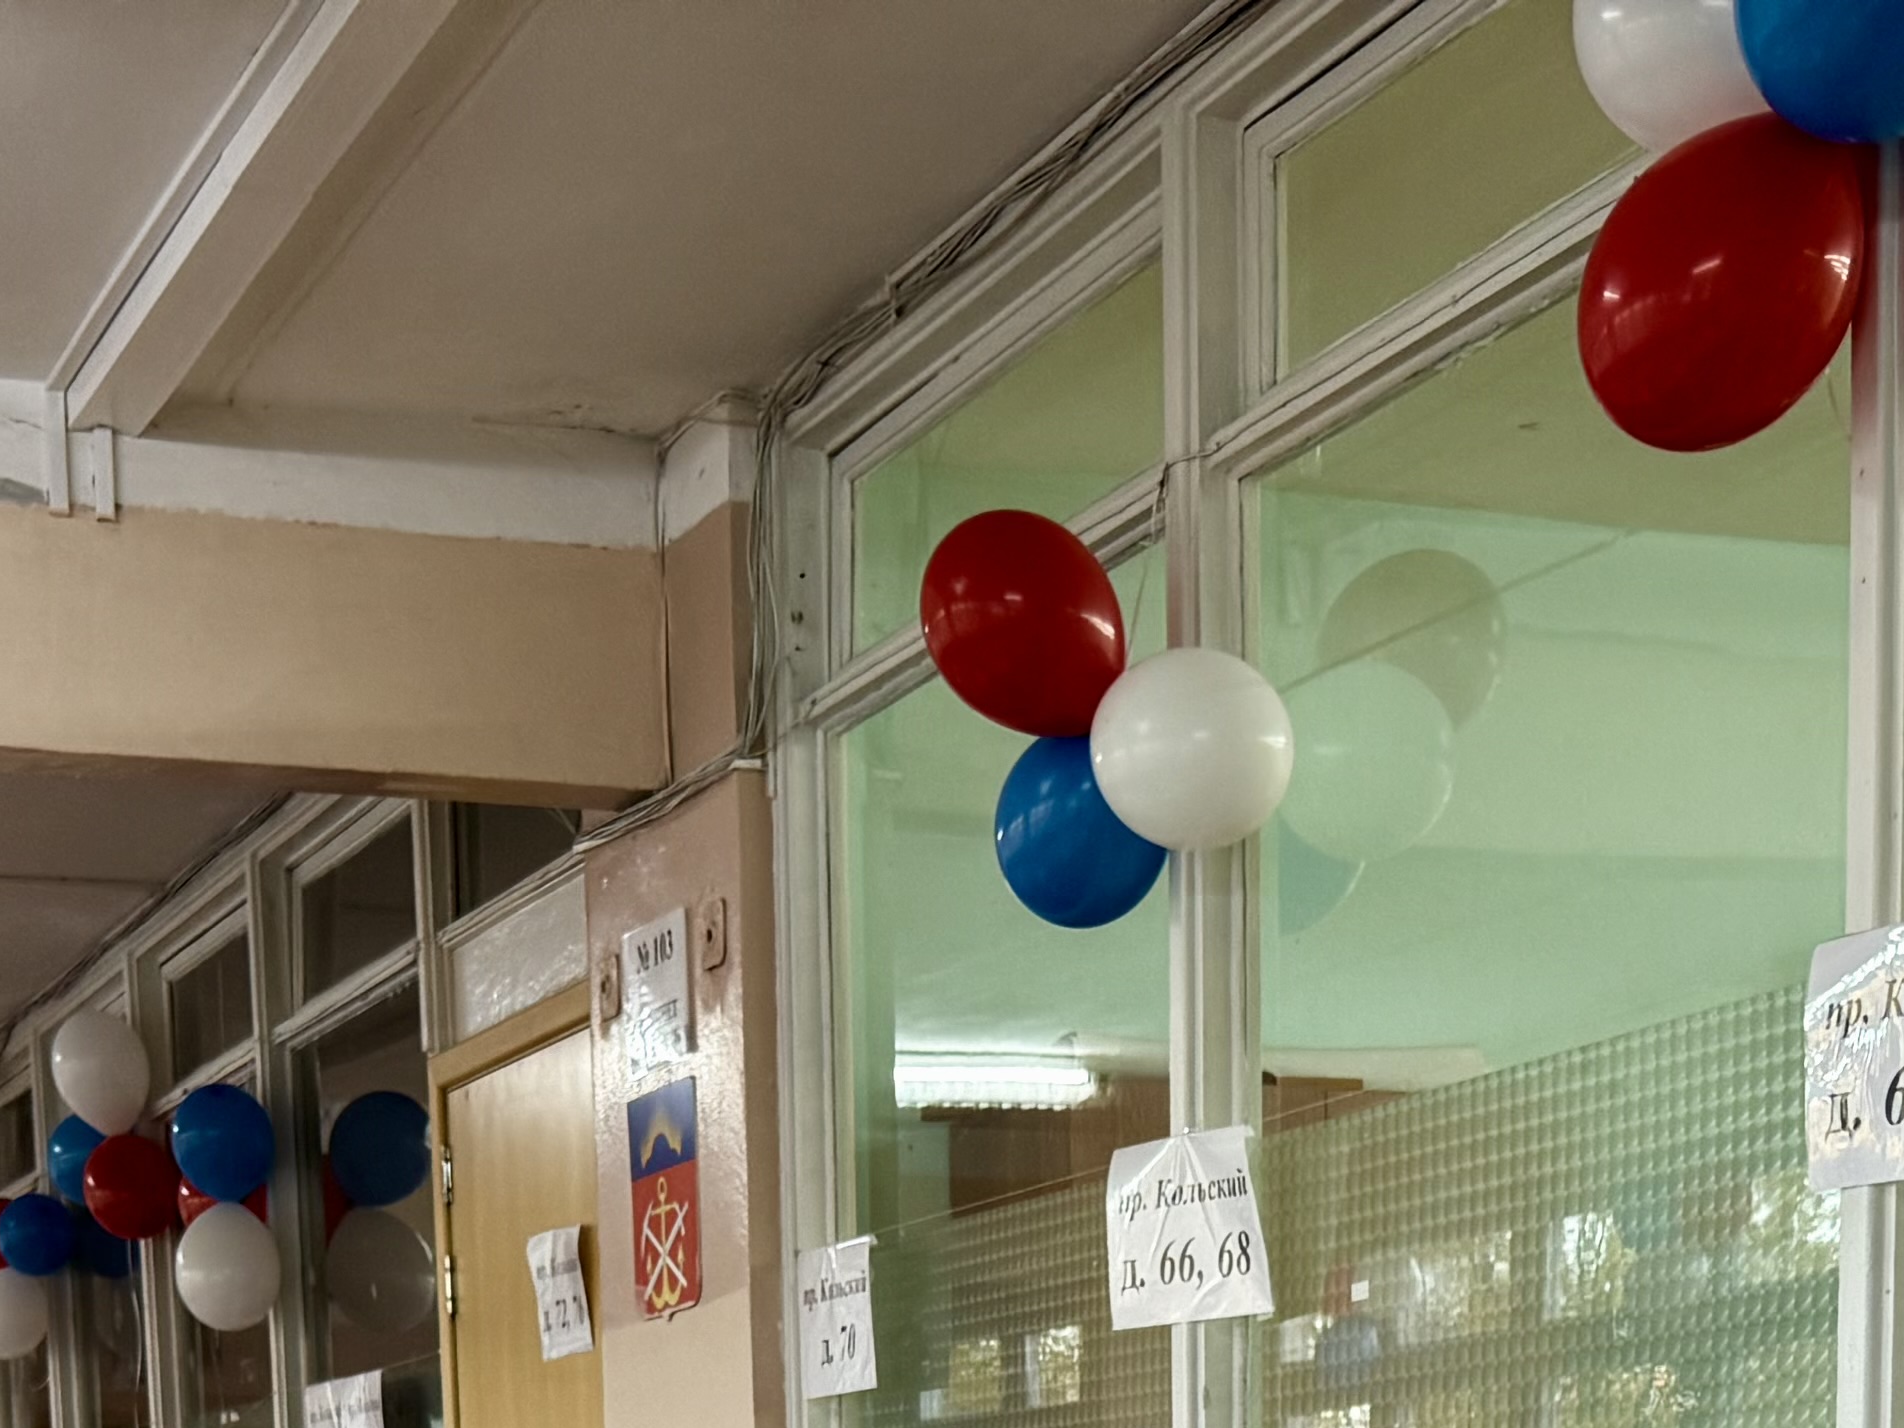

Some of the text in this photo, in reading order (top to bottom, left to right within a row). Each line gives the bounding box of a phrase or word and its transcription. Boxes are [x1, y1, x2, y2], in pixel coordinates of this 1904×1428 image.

[1825, 999, 1869, 1039] пр.
[1156, 1168, 1248, 1211] Кольский
[1160, 1238, 1204, 1289] 66,
[1218, 1230, 1251, 1278] 68
